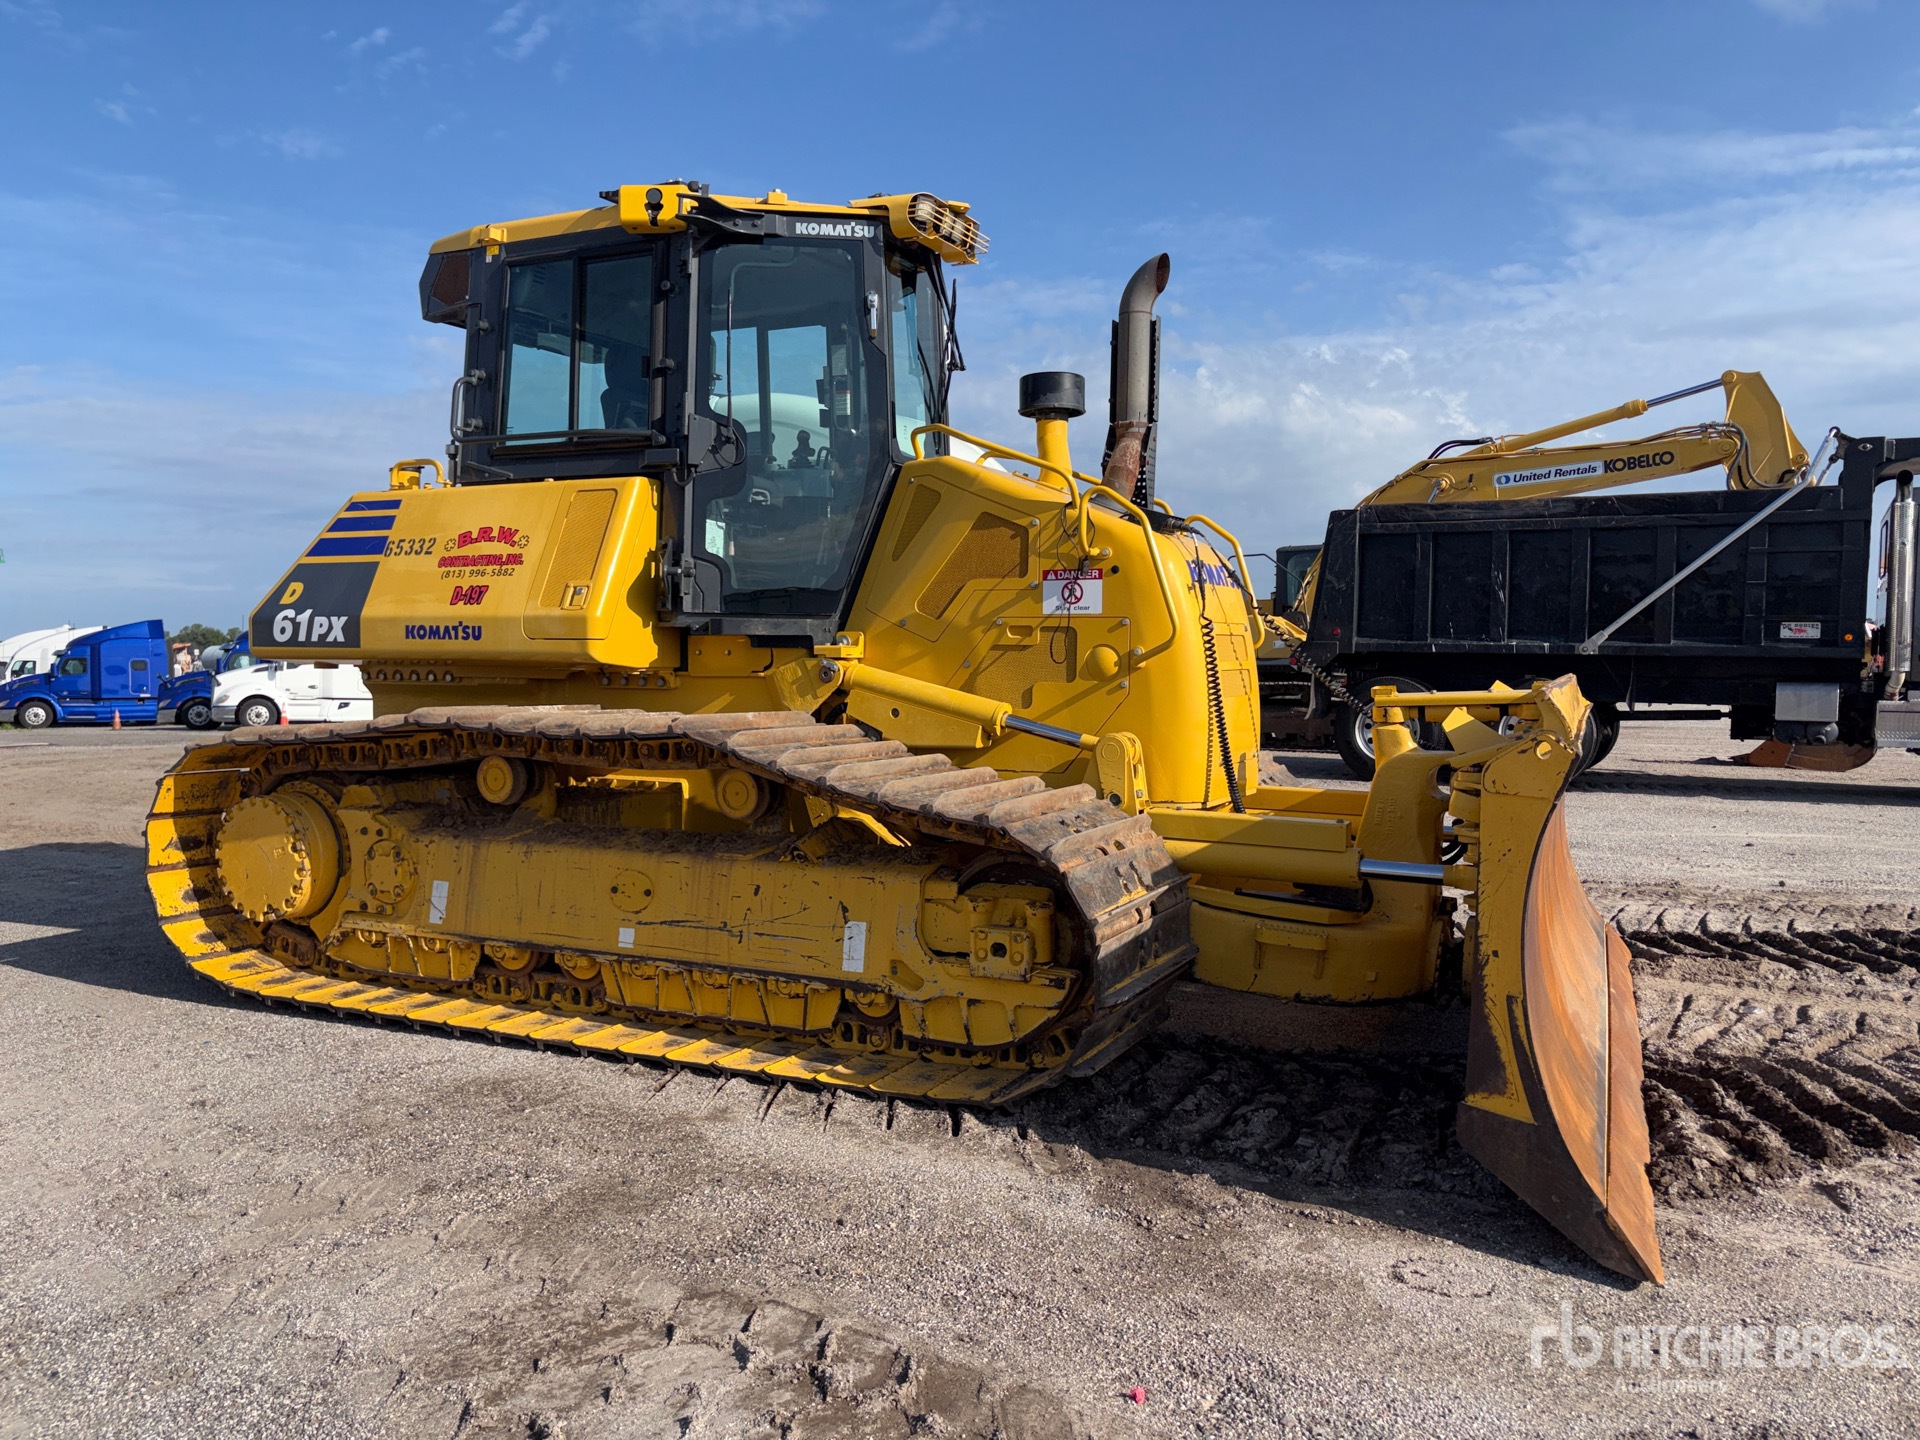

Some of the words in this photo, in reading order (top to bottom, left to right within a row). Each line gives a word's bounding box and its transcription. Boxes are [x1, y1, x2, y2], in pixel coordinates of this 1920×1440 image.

[796, 222, 875, 238] KOMATSU
[1603, 451, 1675, 474] KOBELCO
[1513, 470, 1551, 483] United
[1554, 464, 1598, 478] Rentals
[384, 537, 437, 558] 65332
[457, 525, 519, 549] B.R.W.
[441, 569, 466, 580] (813)
[468, 567, 515, 578] 996-5882
[279, 582, 304, 605] D
[450, 585, 489, 606] D-197
[272, 609, 348, 642] 61PX
[405, 621, 482, 641] KOMATSU
